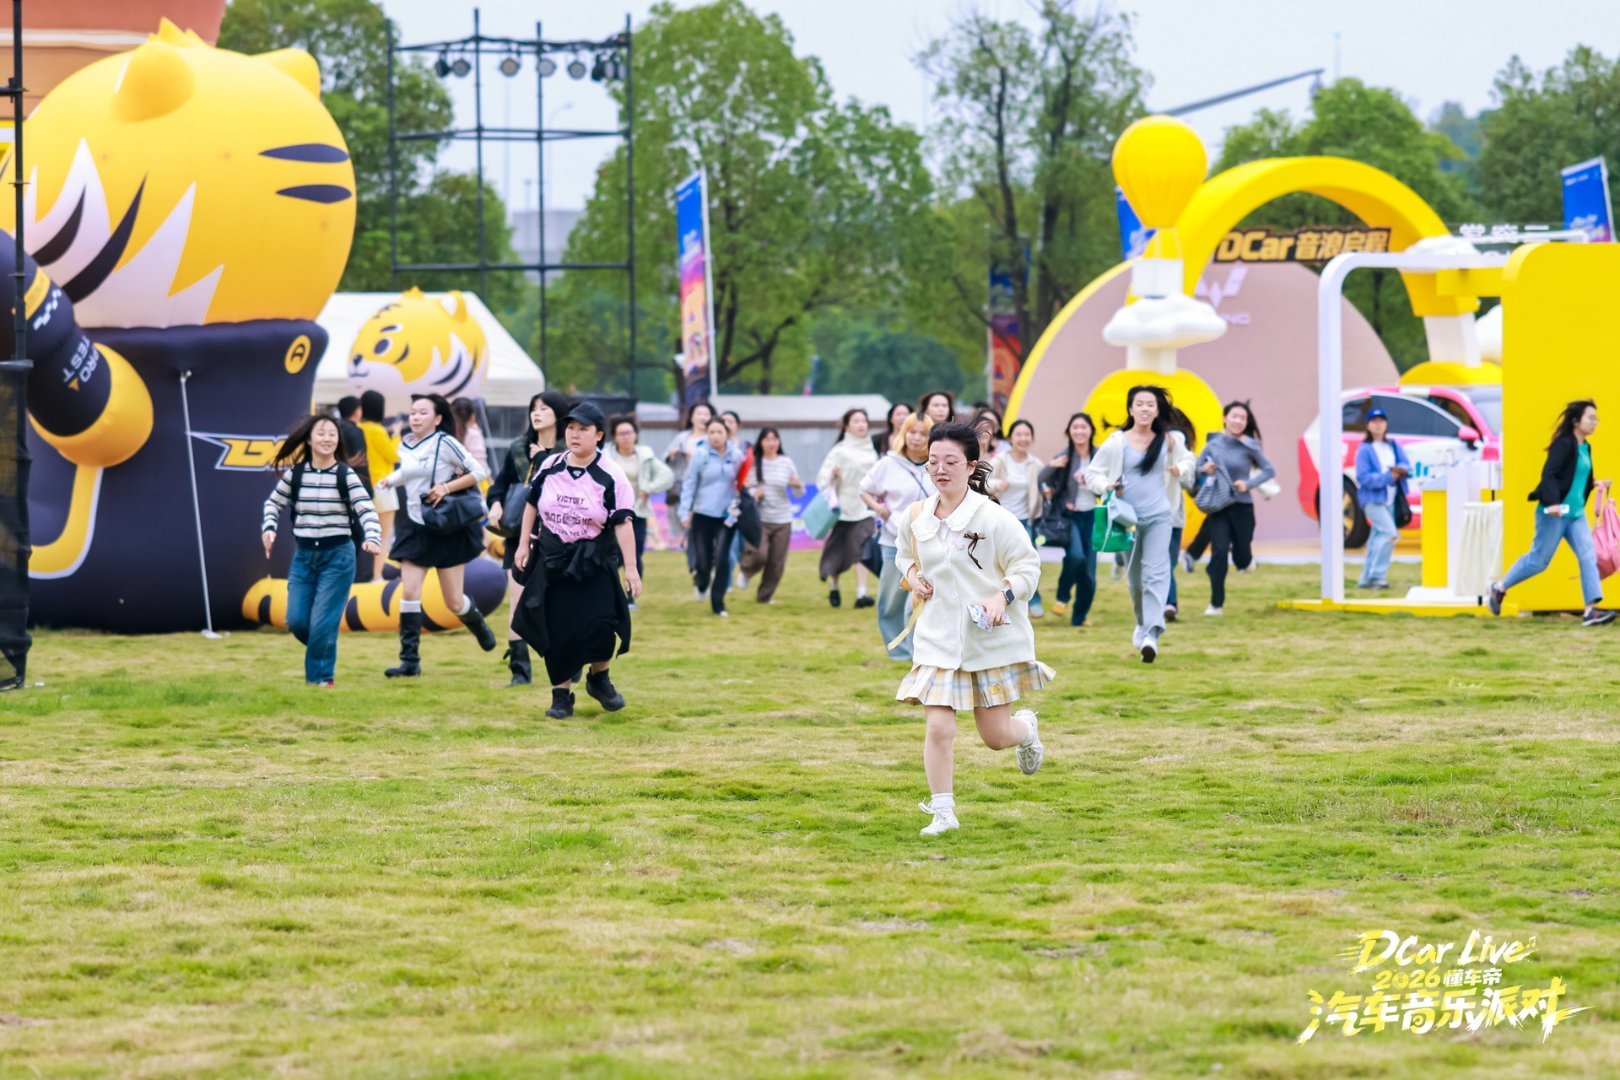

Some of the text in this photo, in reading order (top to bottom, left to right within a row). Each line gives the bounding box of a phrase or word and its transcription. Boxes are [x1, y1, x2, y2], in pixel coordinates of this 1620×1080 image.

[1216, 230, 1295, 261] DCar
[62, 335, 91, 383] TEST
[79, 347, 101, 383] PRO
[556, 494, 586, 505] VICTORY
